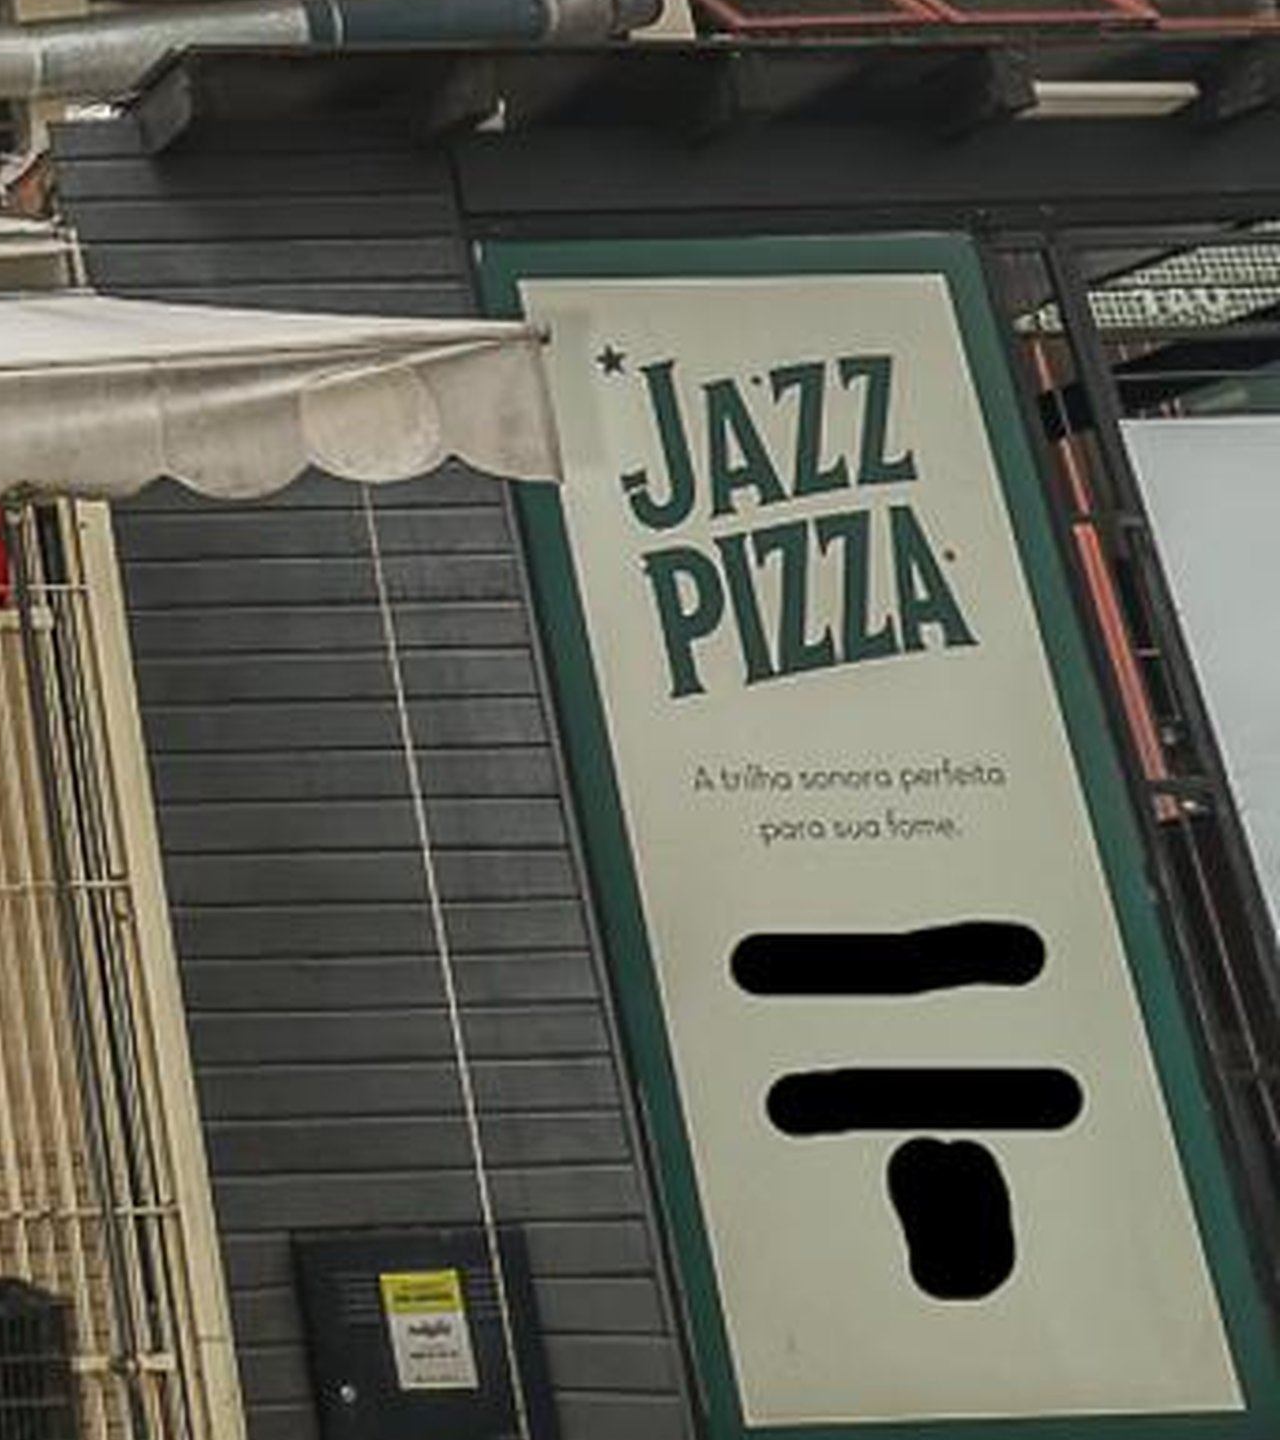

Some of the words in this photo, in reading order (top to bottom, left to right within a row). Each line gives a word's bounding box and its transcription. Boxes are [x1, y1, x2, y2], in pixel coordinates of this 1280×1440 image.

[620, 355, 918, 531] JAZZ
[640, 504, 981, 699] PIZZA
[692, 765, 716, 792] A
[719, 763, 792, 792] trilha
[798, 767, 893, 791] sonora
[899, 758, 1007, 795] perfeita
[758, 818, 827, 848] para
[832, 817, 881, 841] sua
